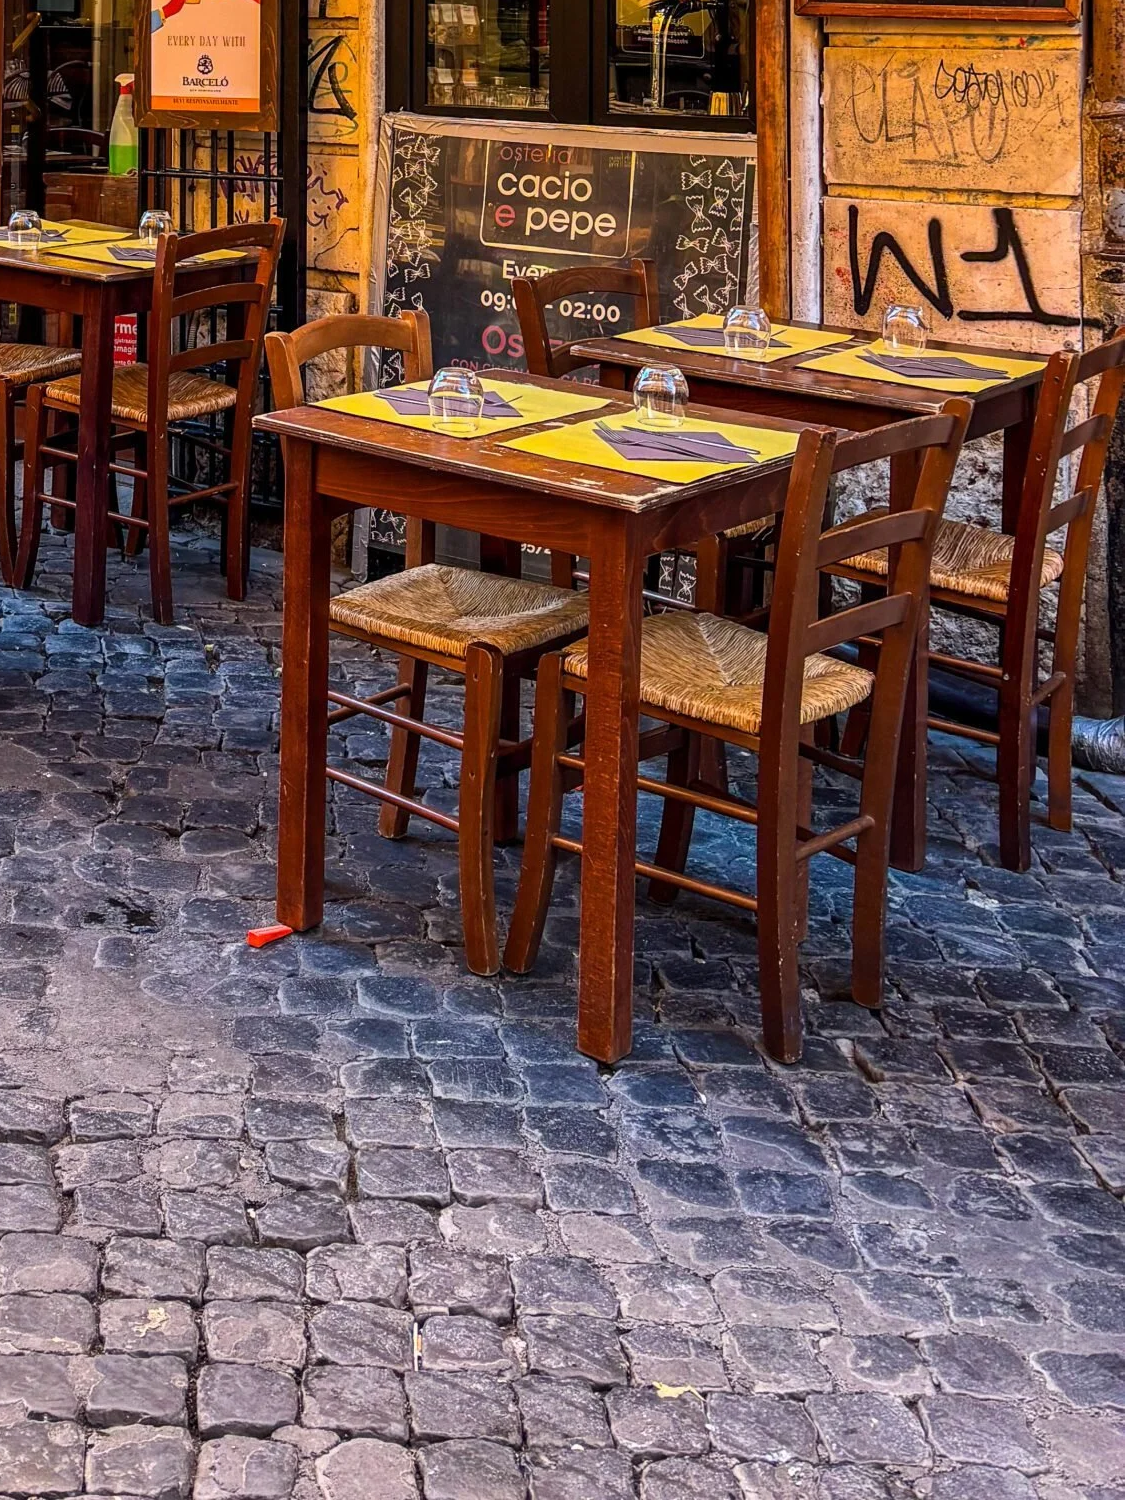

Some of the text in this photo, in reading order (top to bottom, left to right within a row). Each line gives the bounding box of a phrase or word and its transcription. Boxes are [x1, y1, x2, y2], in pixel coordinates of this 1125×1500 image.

[167, 35, 246, 48] EVERY DAY WITH
[182, 75, 229, 88] BARCELÓ
[497, 170, 593, 202] cacio
[494, 204, 617, 241] e pepe
[559, 299, 621, 323] 02:00
